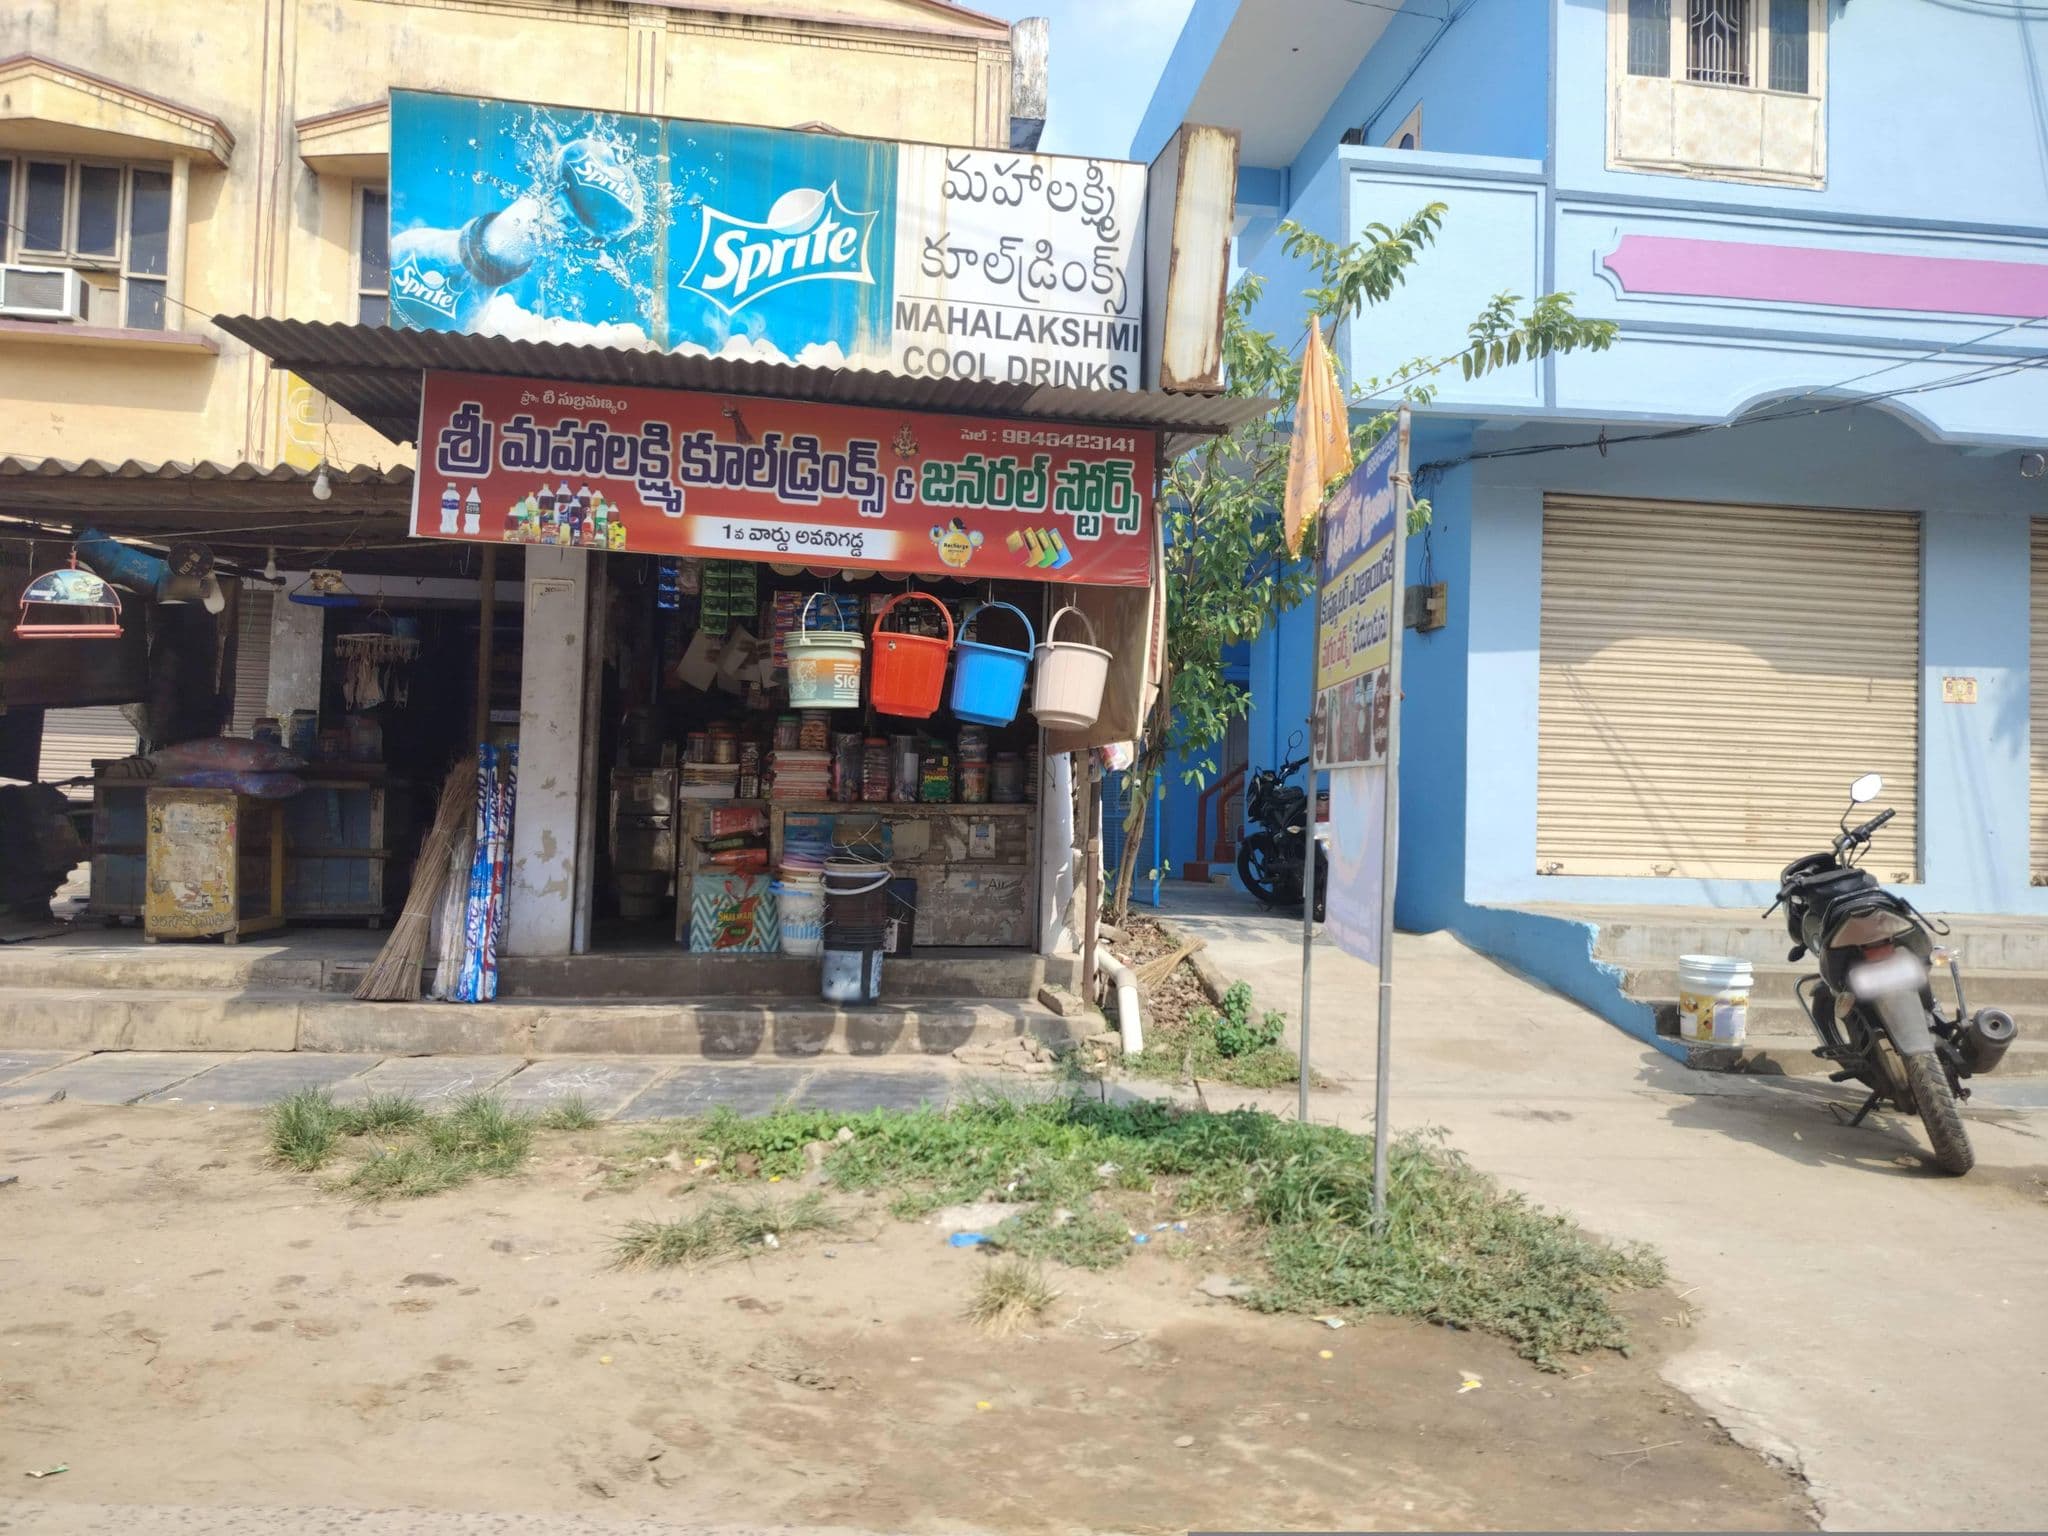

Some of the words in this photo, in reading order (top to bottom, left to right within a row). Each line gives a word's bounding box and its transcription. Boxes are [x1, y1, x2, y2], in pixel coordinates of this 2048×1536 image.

[572, 158, 634, 203] Sprite
[702, 208, 857, 297] Sprite
[395, 265, 453, 308] Sprite
[895, 301, 1139, 353] MAHALAKSHMI
[903, 346, 997, 382] COOL
[1007, 355, 1128, 392] DRINKS
[437, 401, 493, 477] శ్రీ
[894, 467, 917, 502] &
[922, 454, 1050, 511] జనరల్
[1055, 458, 1142, 540] స్టోర్స్
[748, 527, 791, 551] వార్డు
[796, 529, 864, 557] అవనిగడ్డ
[943, 542, 969, 550] Recharge
